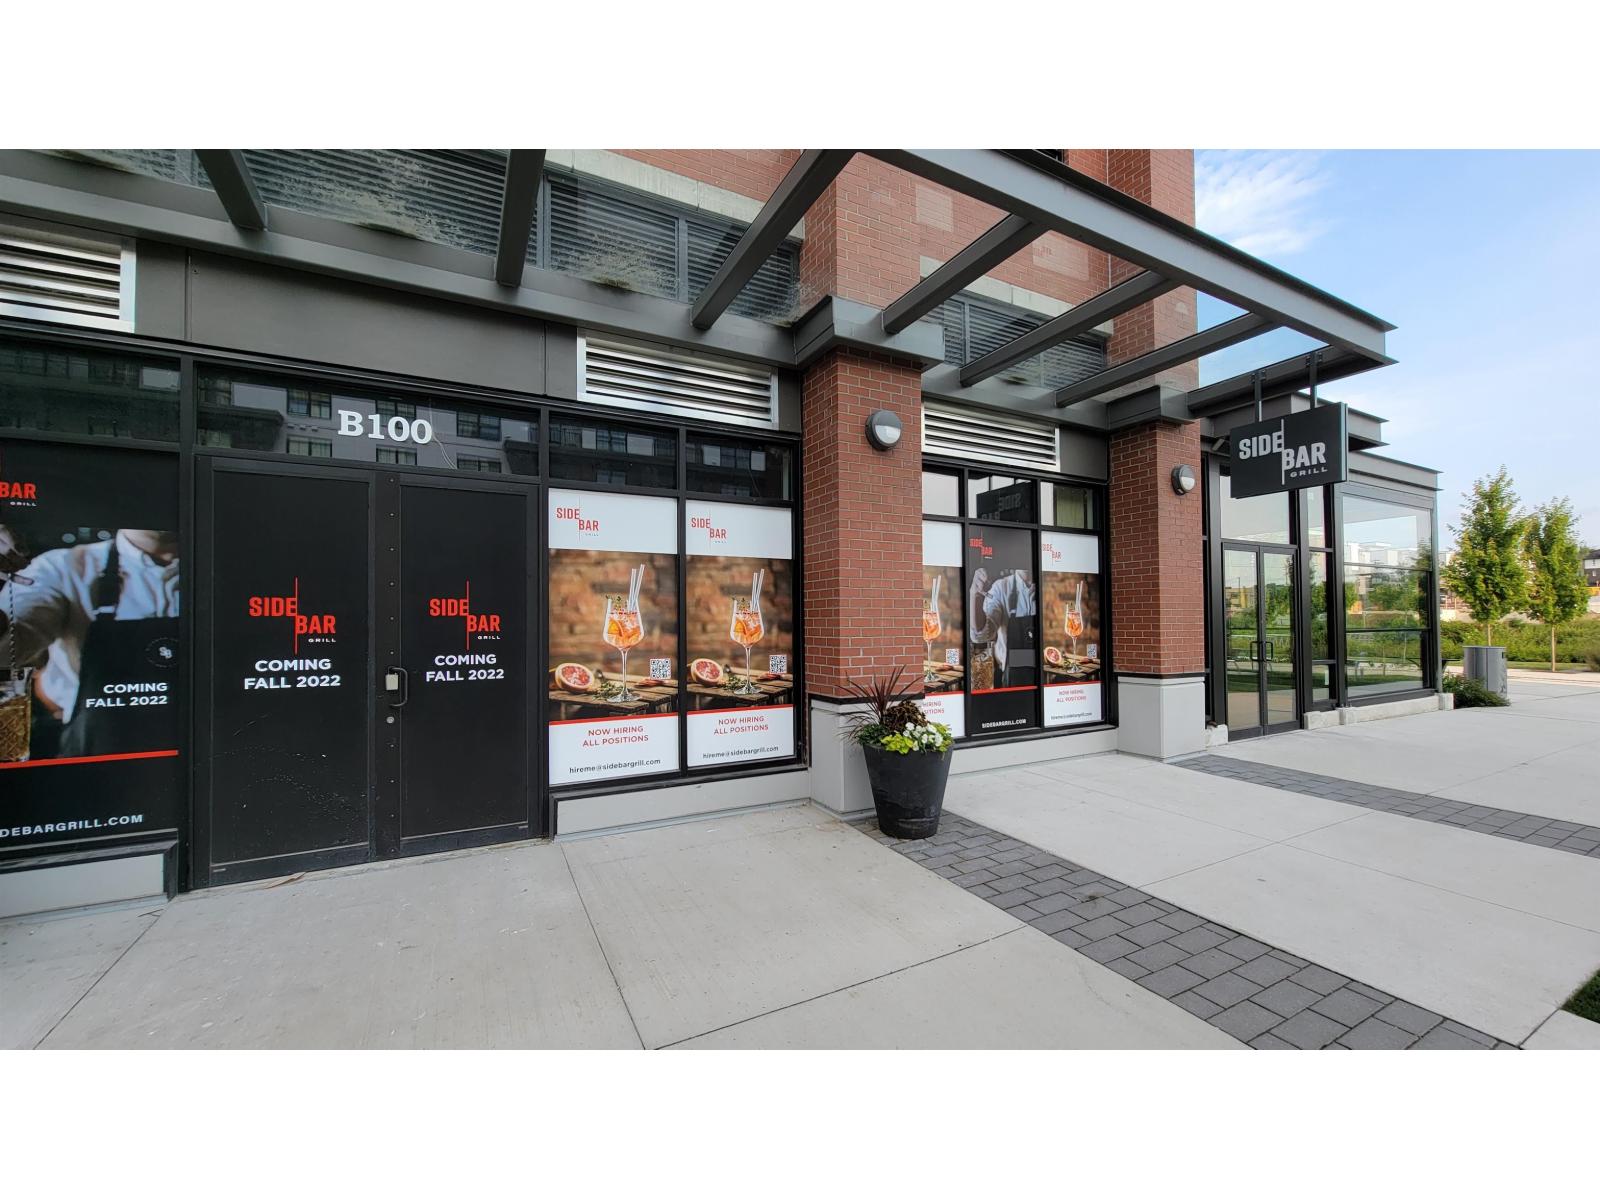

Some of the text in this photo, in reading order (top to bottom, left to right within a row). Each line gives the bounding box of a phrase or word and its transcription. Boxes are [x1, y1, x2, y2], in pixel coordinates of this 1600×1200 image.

[337, 409, 432, 444] B100
[1239, 430, 1284, 460] SIDE
[1281, 442, 1327, 471] BAR
[1290, 466, 1328, 478] GRILL
[0, 481, 37, 500] BAR
[556, 507, 580, 520] SIDE
[579, 519, 599, 531] BAR
[691, 517, 710, 529] SIDE
[709, 528, 727, 539] BAR
[249, 596, 298, 617] SIDE
[429, 598, 469, 617] SIDE
[295, 615, 336, 634] BAR
[467, 615, 501, 632] BAR
[254, 658, 332, 672] COMING
[434, 653, 497, 666] COMING
[426, 668, 505, 682] FALL 2022
[103, 682, 168, 694] COMING
[244, 675, 341, 690] FALL 2022
[85, 695, 168, 708] FALL 2022
[923, 707, 945, 715] SITIONS
[718, 715, 765, 726] NOW HIRING
[588, 725, 644, 737] NOW HIRING
[730, 724, 769, 734] POSITIONS
[582, 734, 649, 748] ALL POSITIONS
[0, 814, 143, 838] DEBARGRILL.COM
